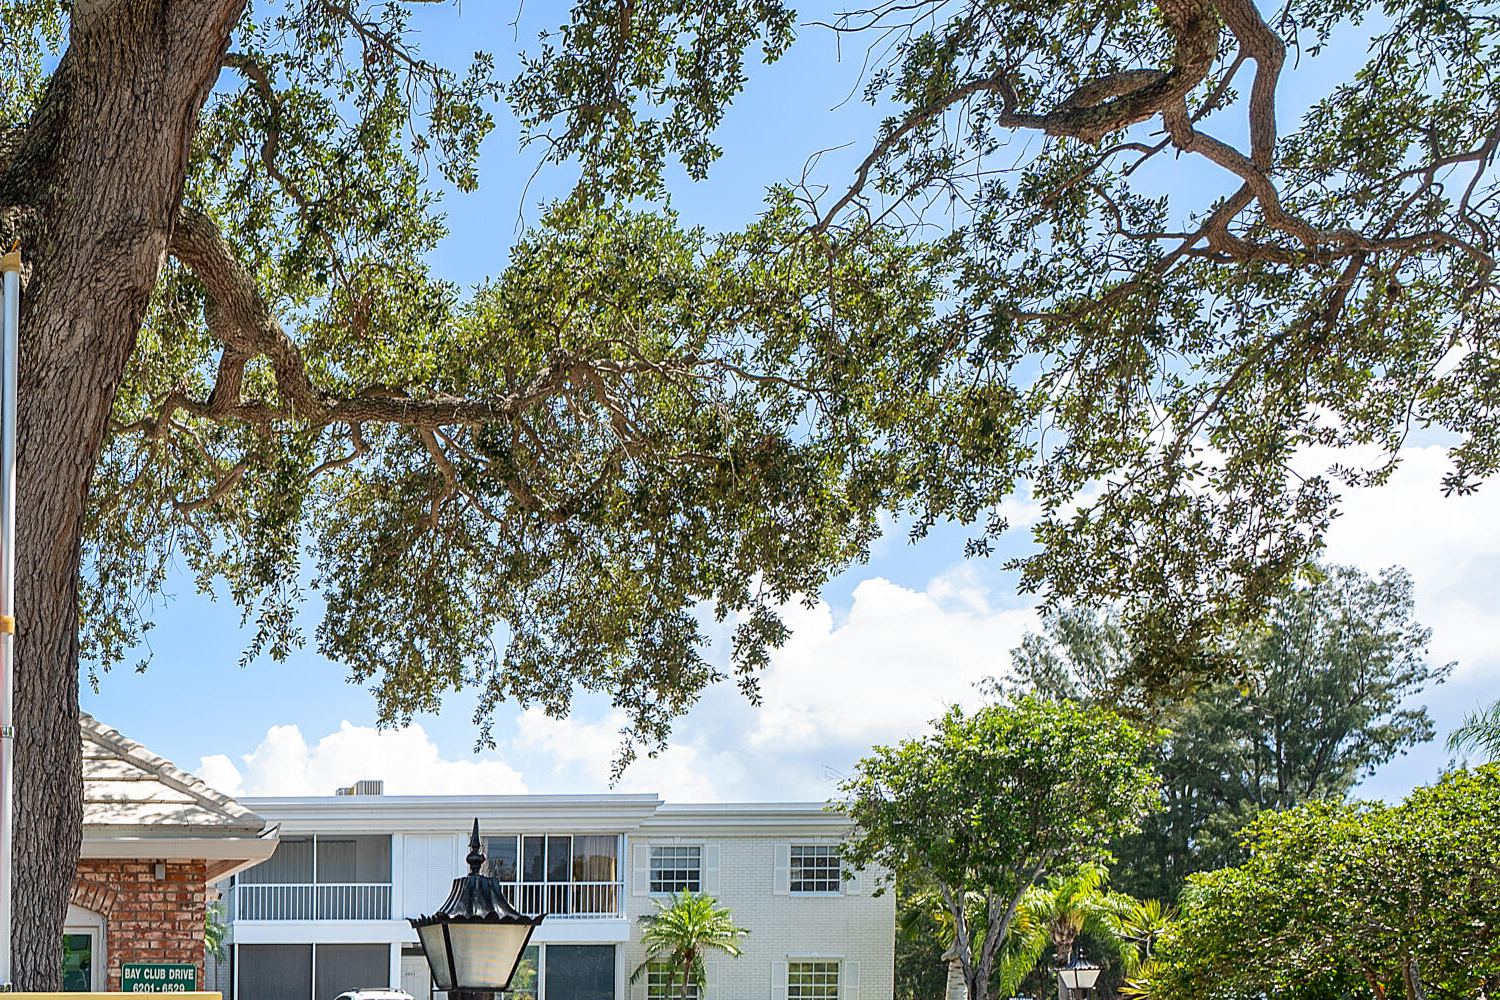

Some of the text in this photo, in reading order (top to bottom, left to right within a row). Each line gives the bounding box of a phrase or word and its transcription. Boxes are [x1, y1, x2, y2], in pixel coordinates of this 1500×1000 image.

[124, 968, 194, 980] BAY CLUB DRIVE
